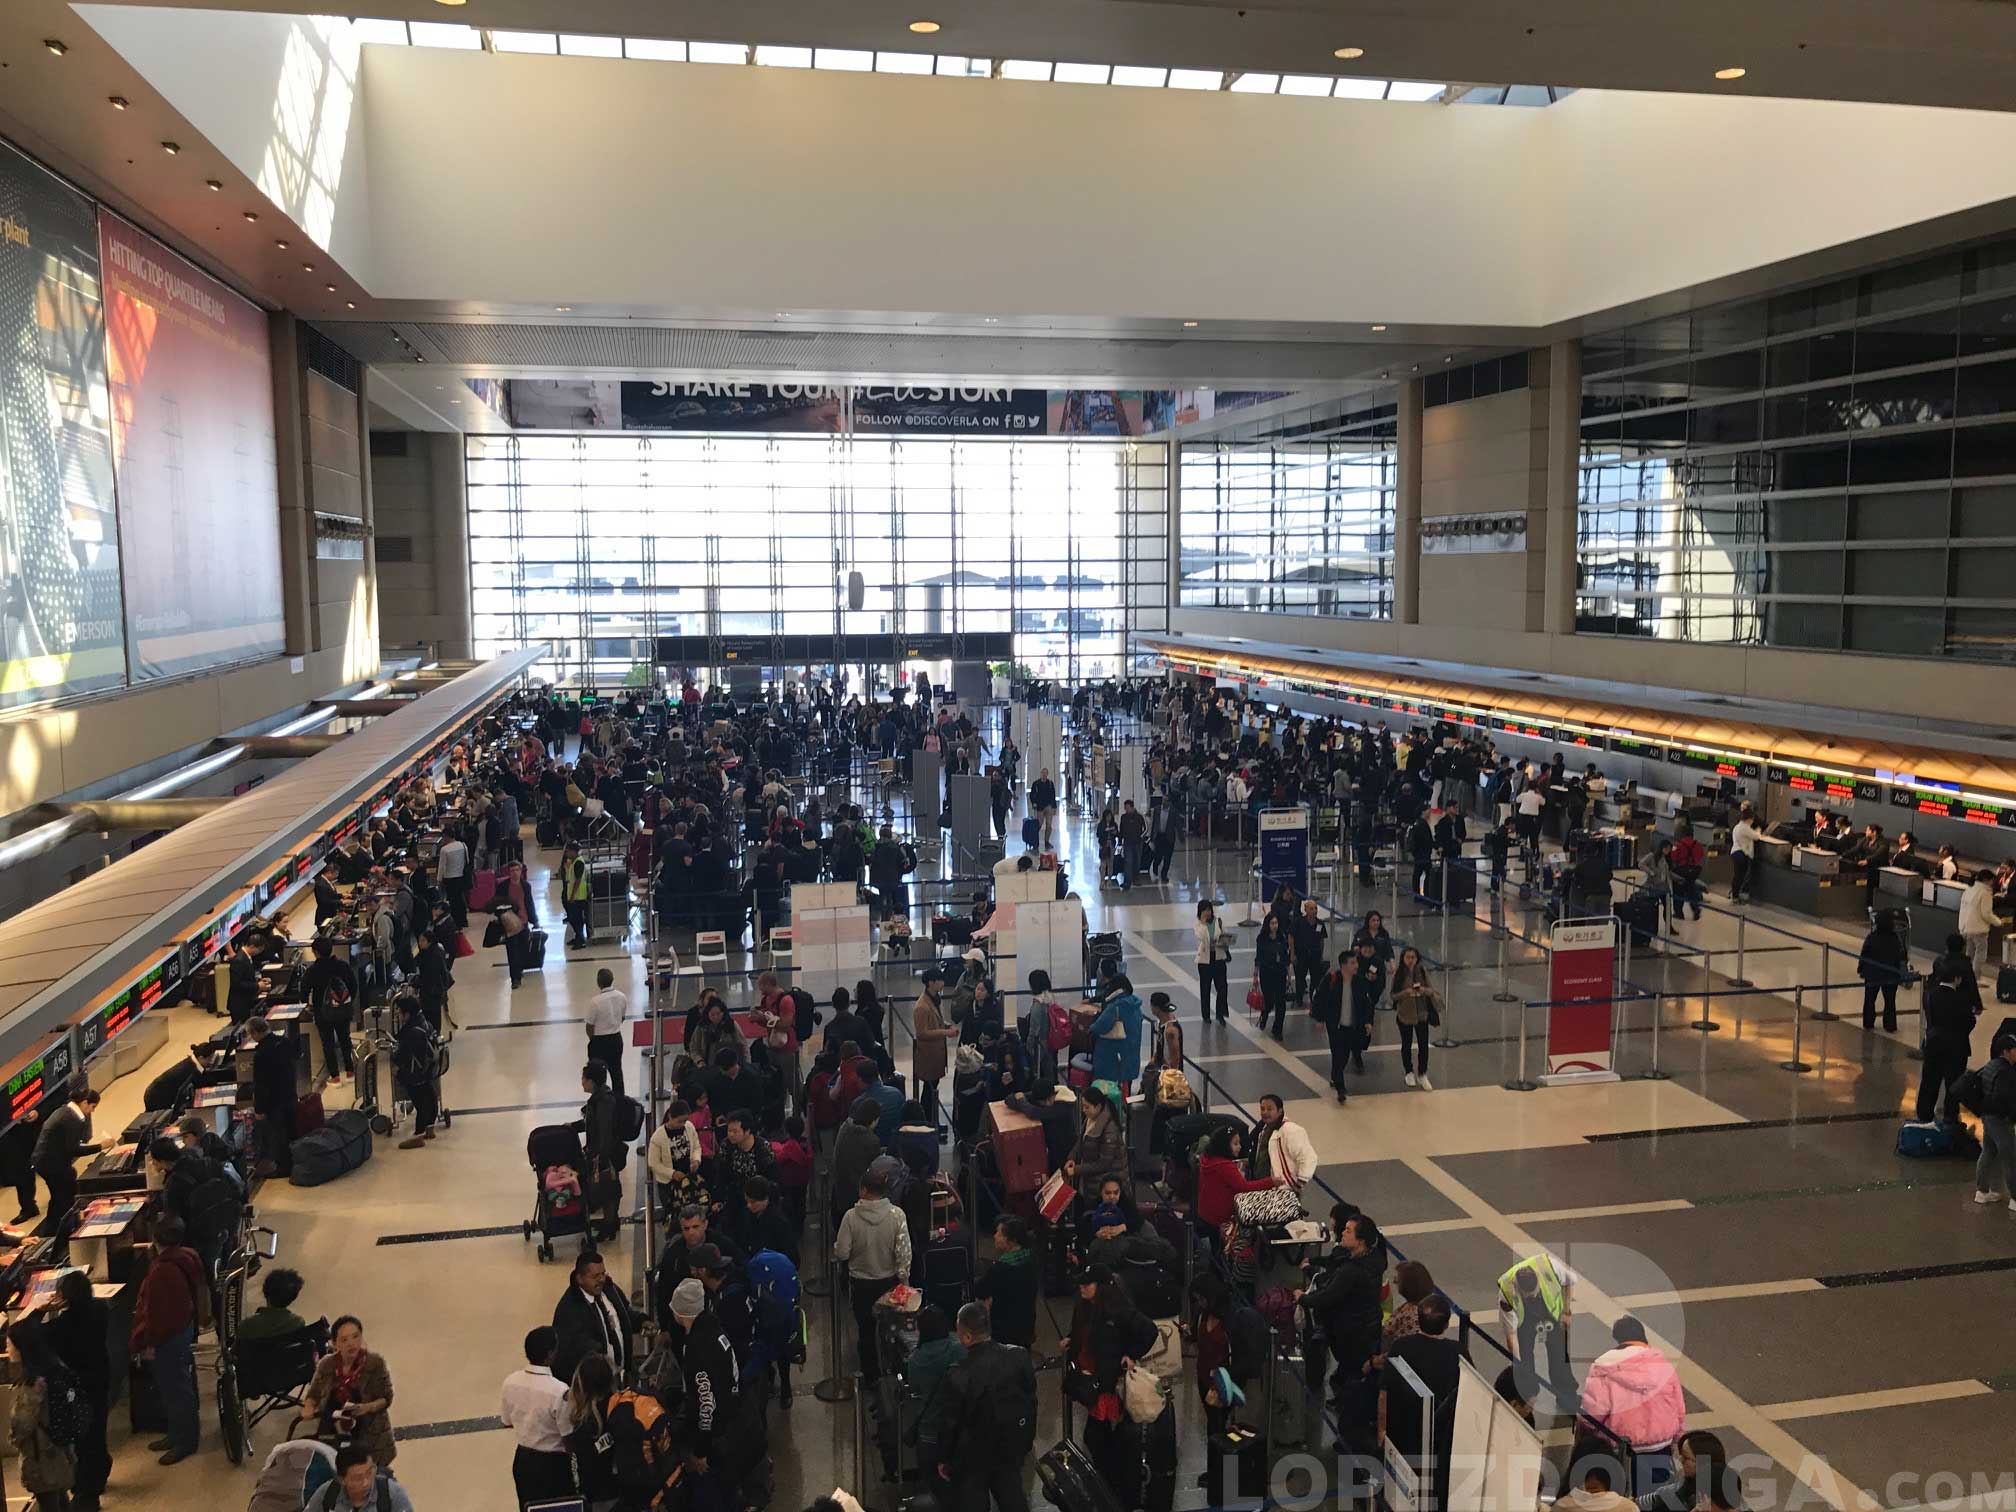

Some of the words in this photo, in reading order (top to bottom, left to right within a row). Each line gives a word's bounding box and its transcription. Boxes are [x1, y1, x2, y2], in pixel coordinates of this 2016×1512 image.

[5, 214, 30, 248] plant
[109, 237, 149, 281] HITTING
[147, 261, 165, 288] TOP
[165, 271, 201, 309] QUARTILE
[856, 414, 903, 426] FOLLOW
[905, 415, 980, 427] @DISCOVERLA
[982, 416, 1000, 427] ON
[64, 619, 116, 644] EMERSON
[1670, 751, 1681, 762] A22
[1743, 765, 1756, 776] A23
[1770, 770, 1783, 780] A24
[1861, 786, 1876, 798] A25
[84, 1024, 98, 1049] A57
[53, 1049, 68, 1076] A58
